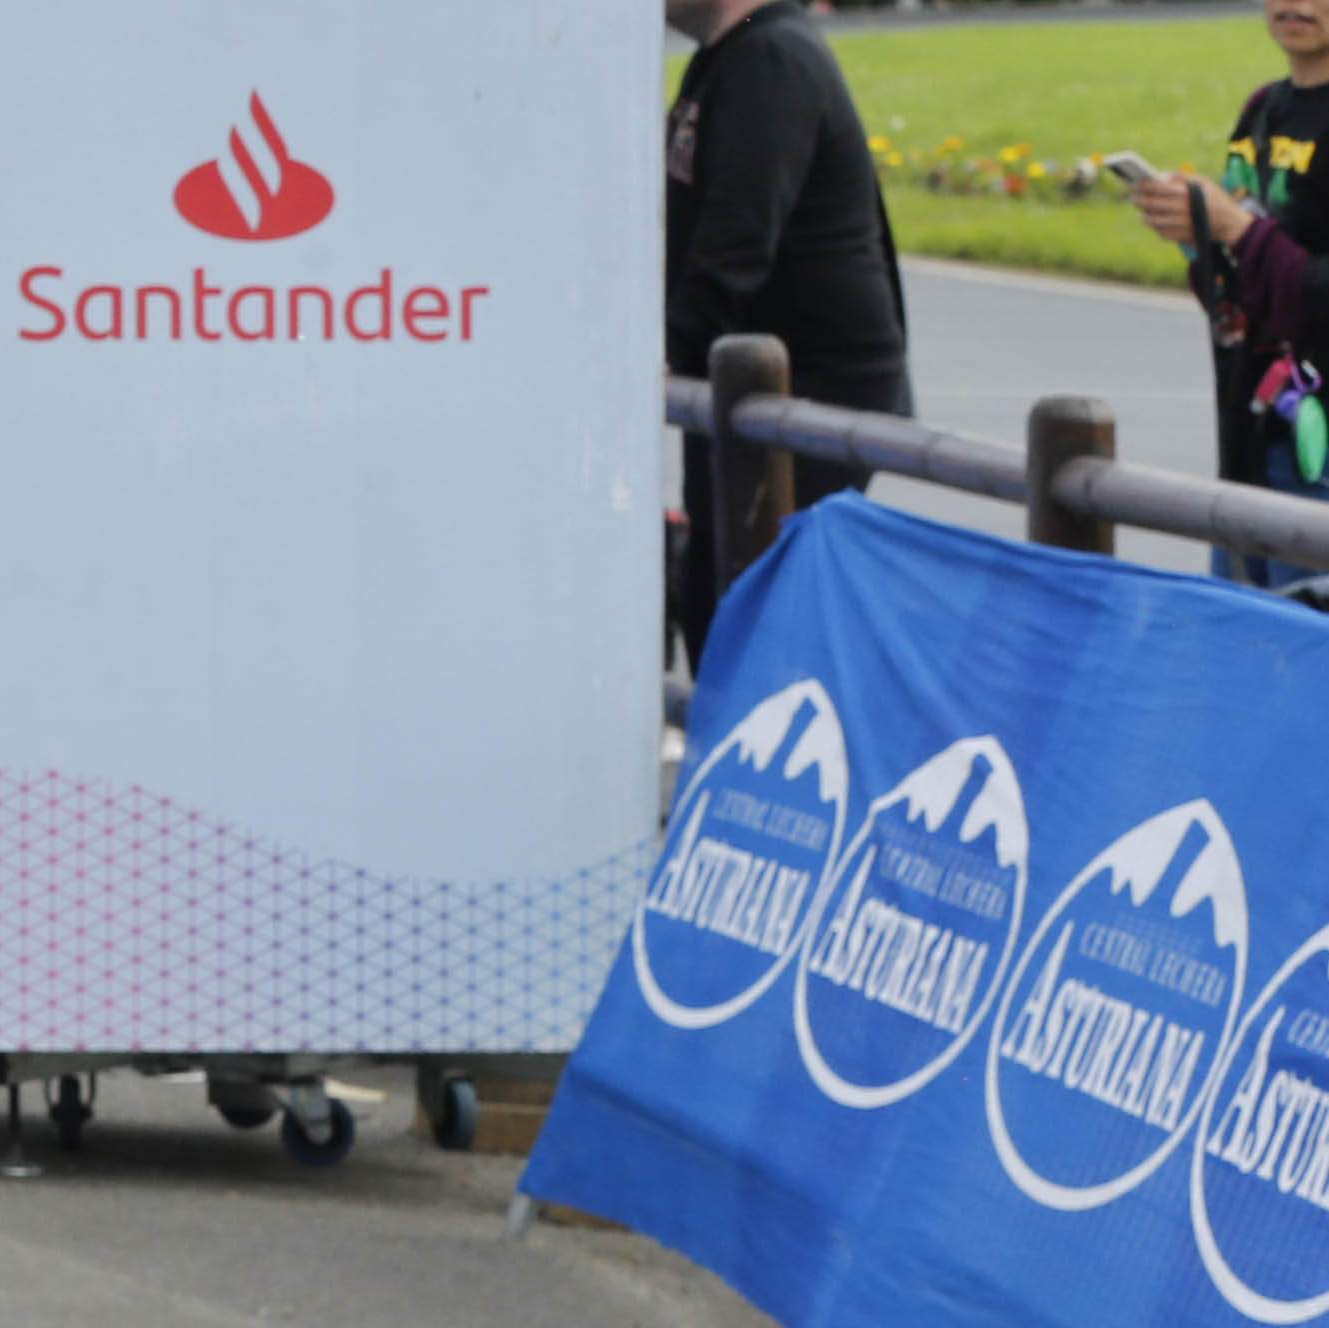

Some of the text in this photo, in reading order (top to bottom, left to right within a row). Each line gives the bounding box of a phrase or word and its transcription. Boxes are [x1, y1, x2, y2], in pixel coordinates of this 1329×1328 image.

[18, 265, 490, 342] Santander
[645, 789, 810, 957] ASTURIANA
[809, 843, 991, 1034] ASTURIANA
[1000, 919, 1205, 1133] ASTURIANA
